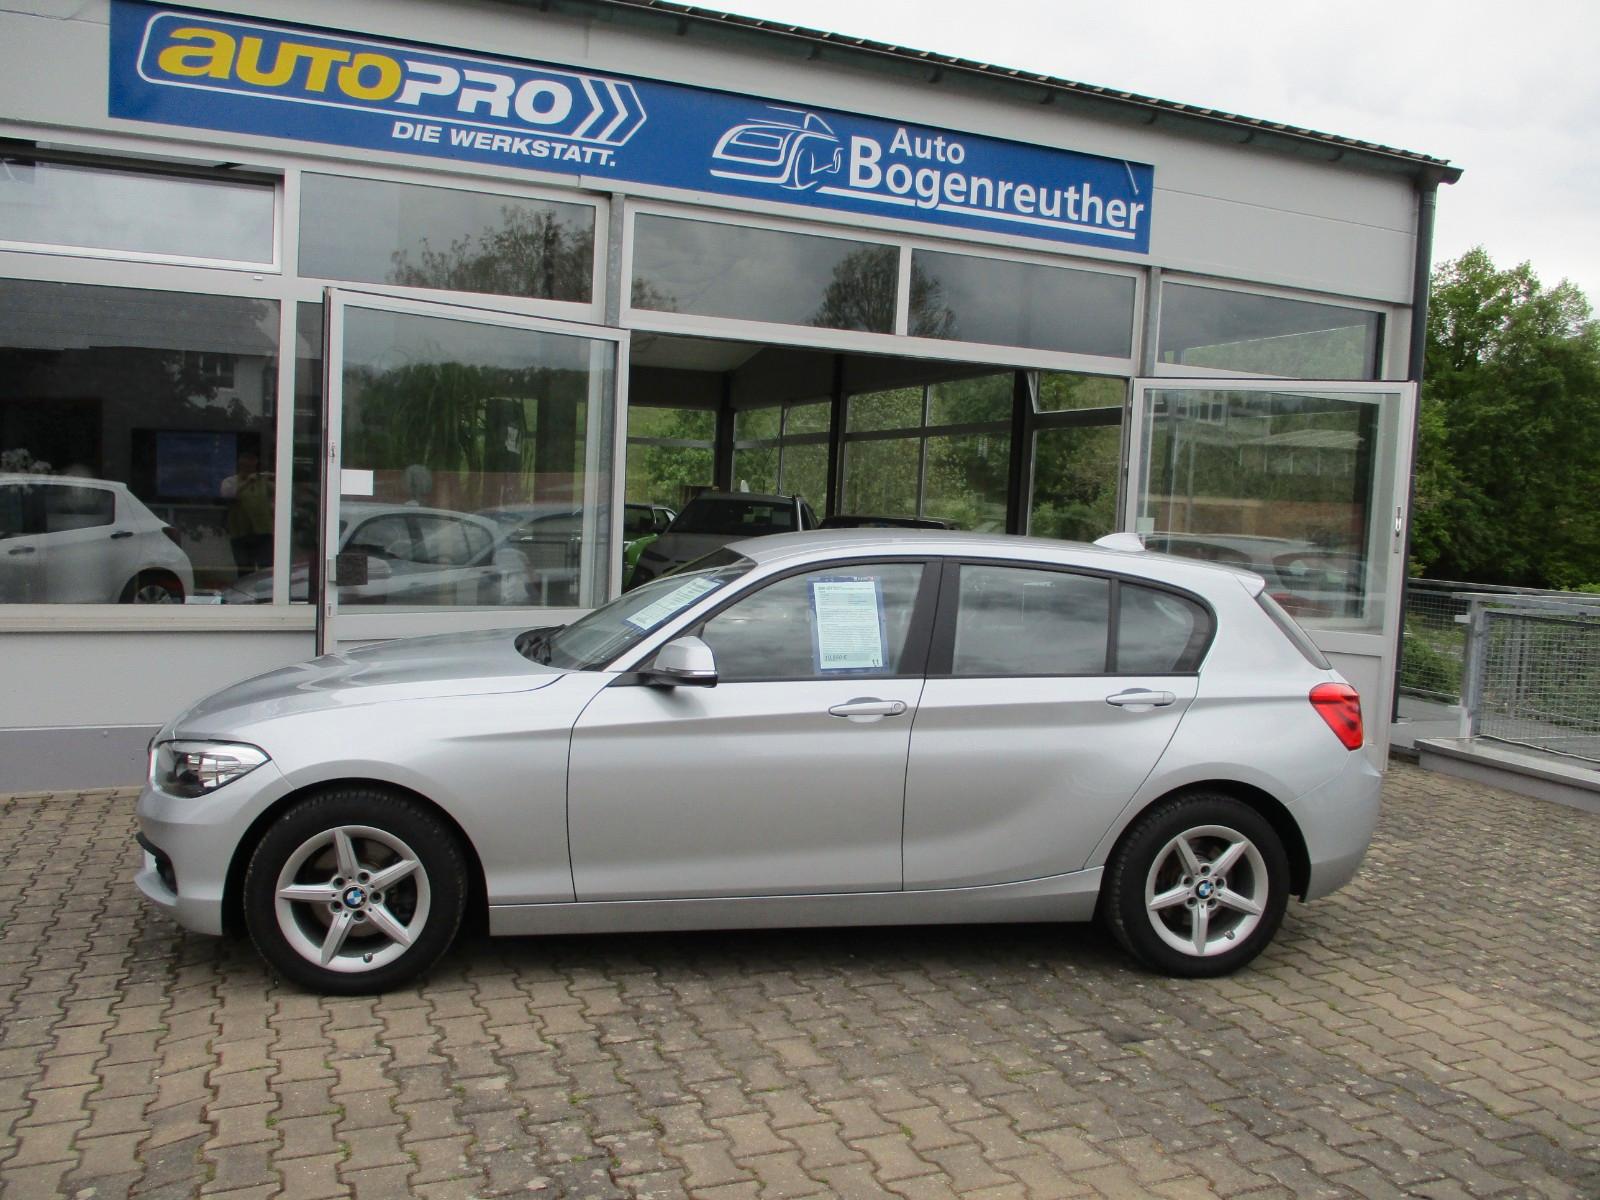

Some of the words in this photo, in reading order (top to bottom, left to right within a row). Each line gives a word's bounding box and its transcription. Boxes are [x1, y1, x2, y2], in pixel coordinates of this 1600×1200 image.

[392, 121, 440, 144] DIE
[450, 128, 617, 168] WERKSTATT.
[889, 128, 966, 165] Auto
[849, 135, 1145, 231] Bogenreuther
